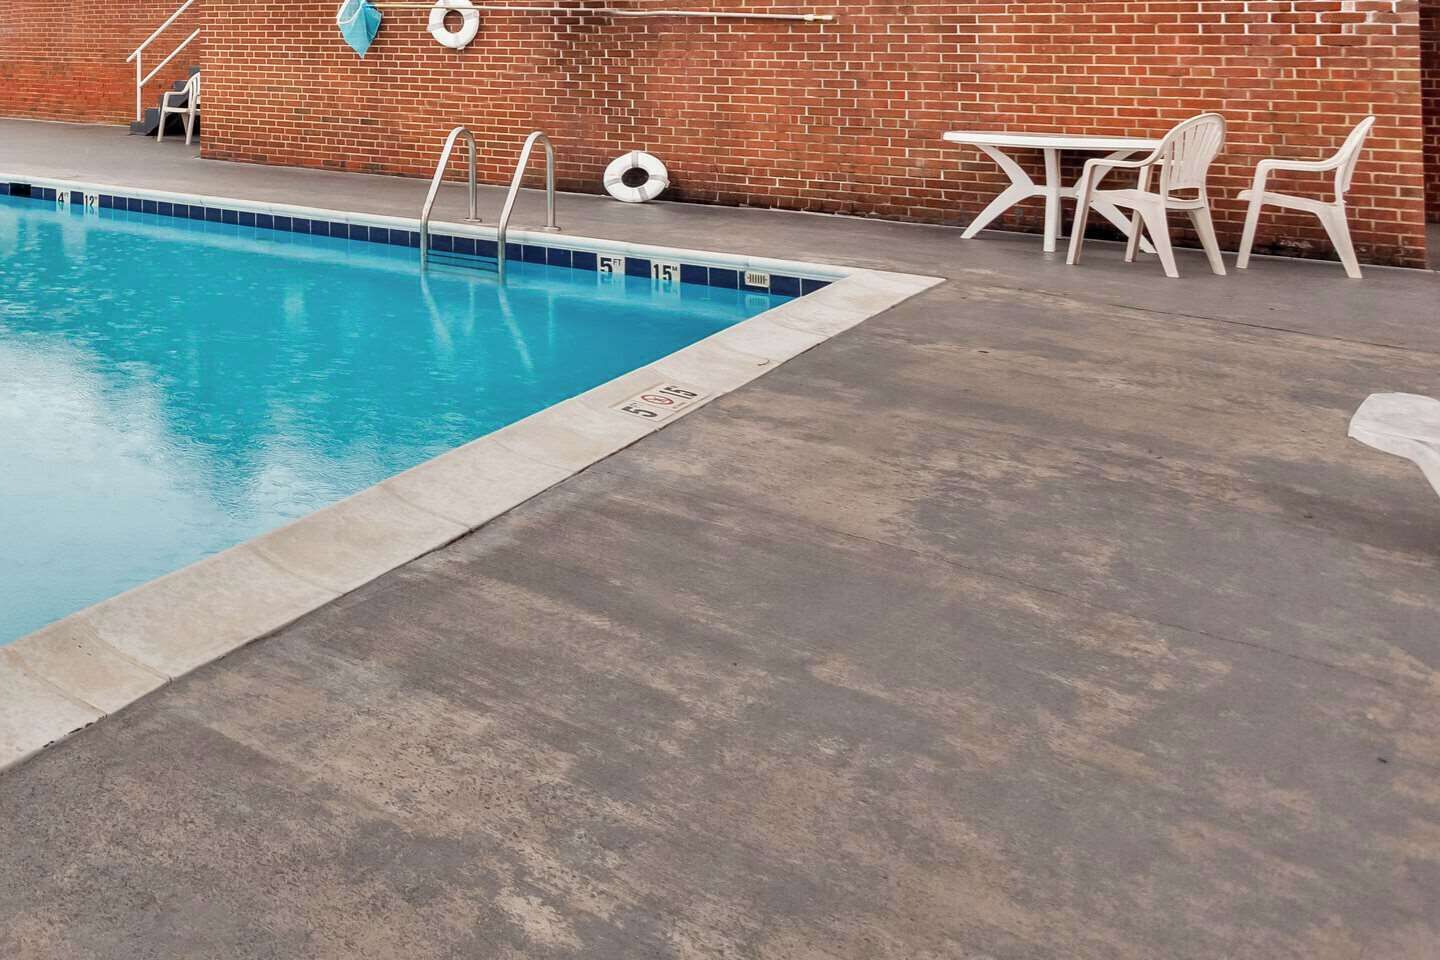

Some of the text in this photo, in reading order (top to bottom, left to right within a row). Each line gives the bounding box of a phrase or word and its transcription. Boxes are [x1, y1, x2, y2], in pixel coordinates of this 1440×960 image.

[58, 192, 64, 203] 4
[85, 195, 94, 207] 12
[600, 257, 623, 273] 5 FT
[621, 406, 658, 417] 5
